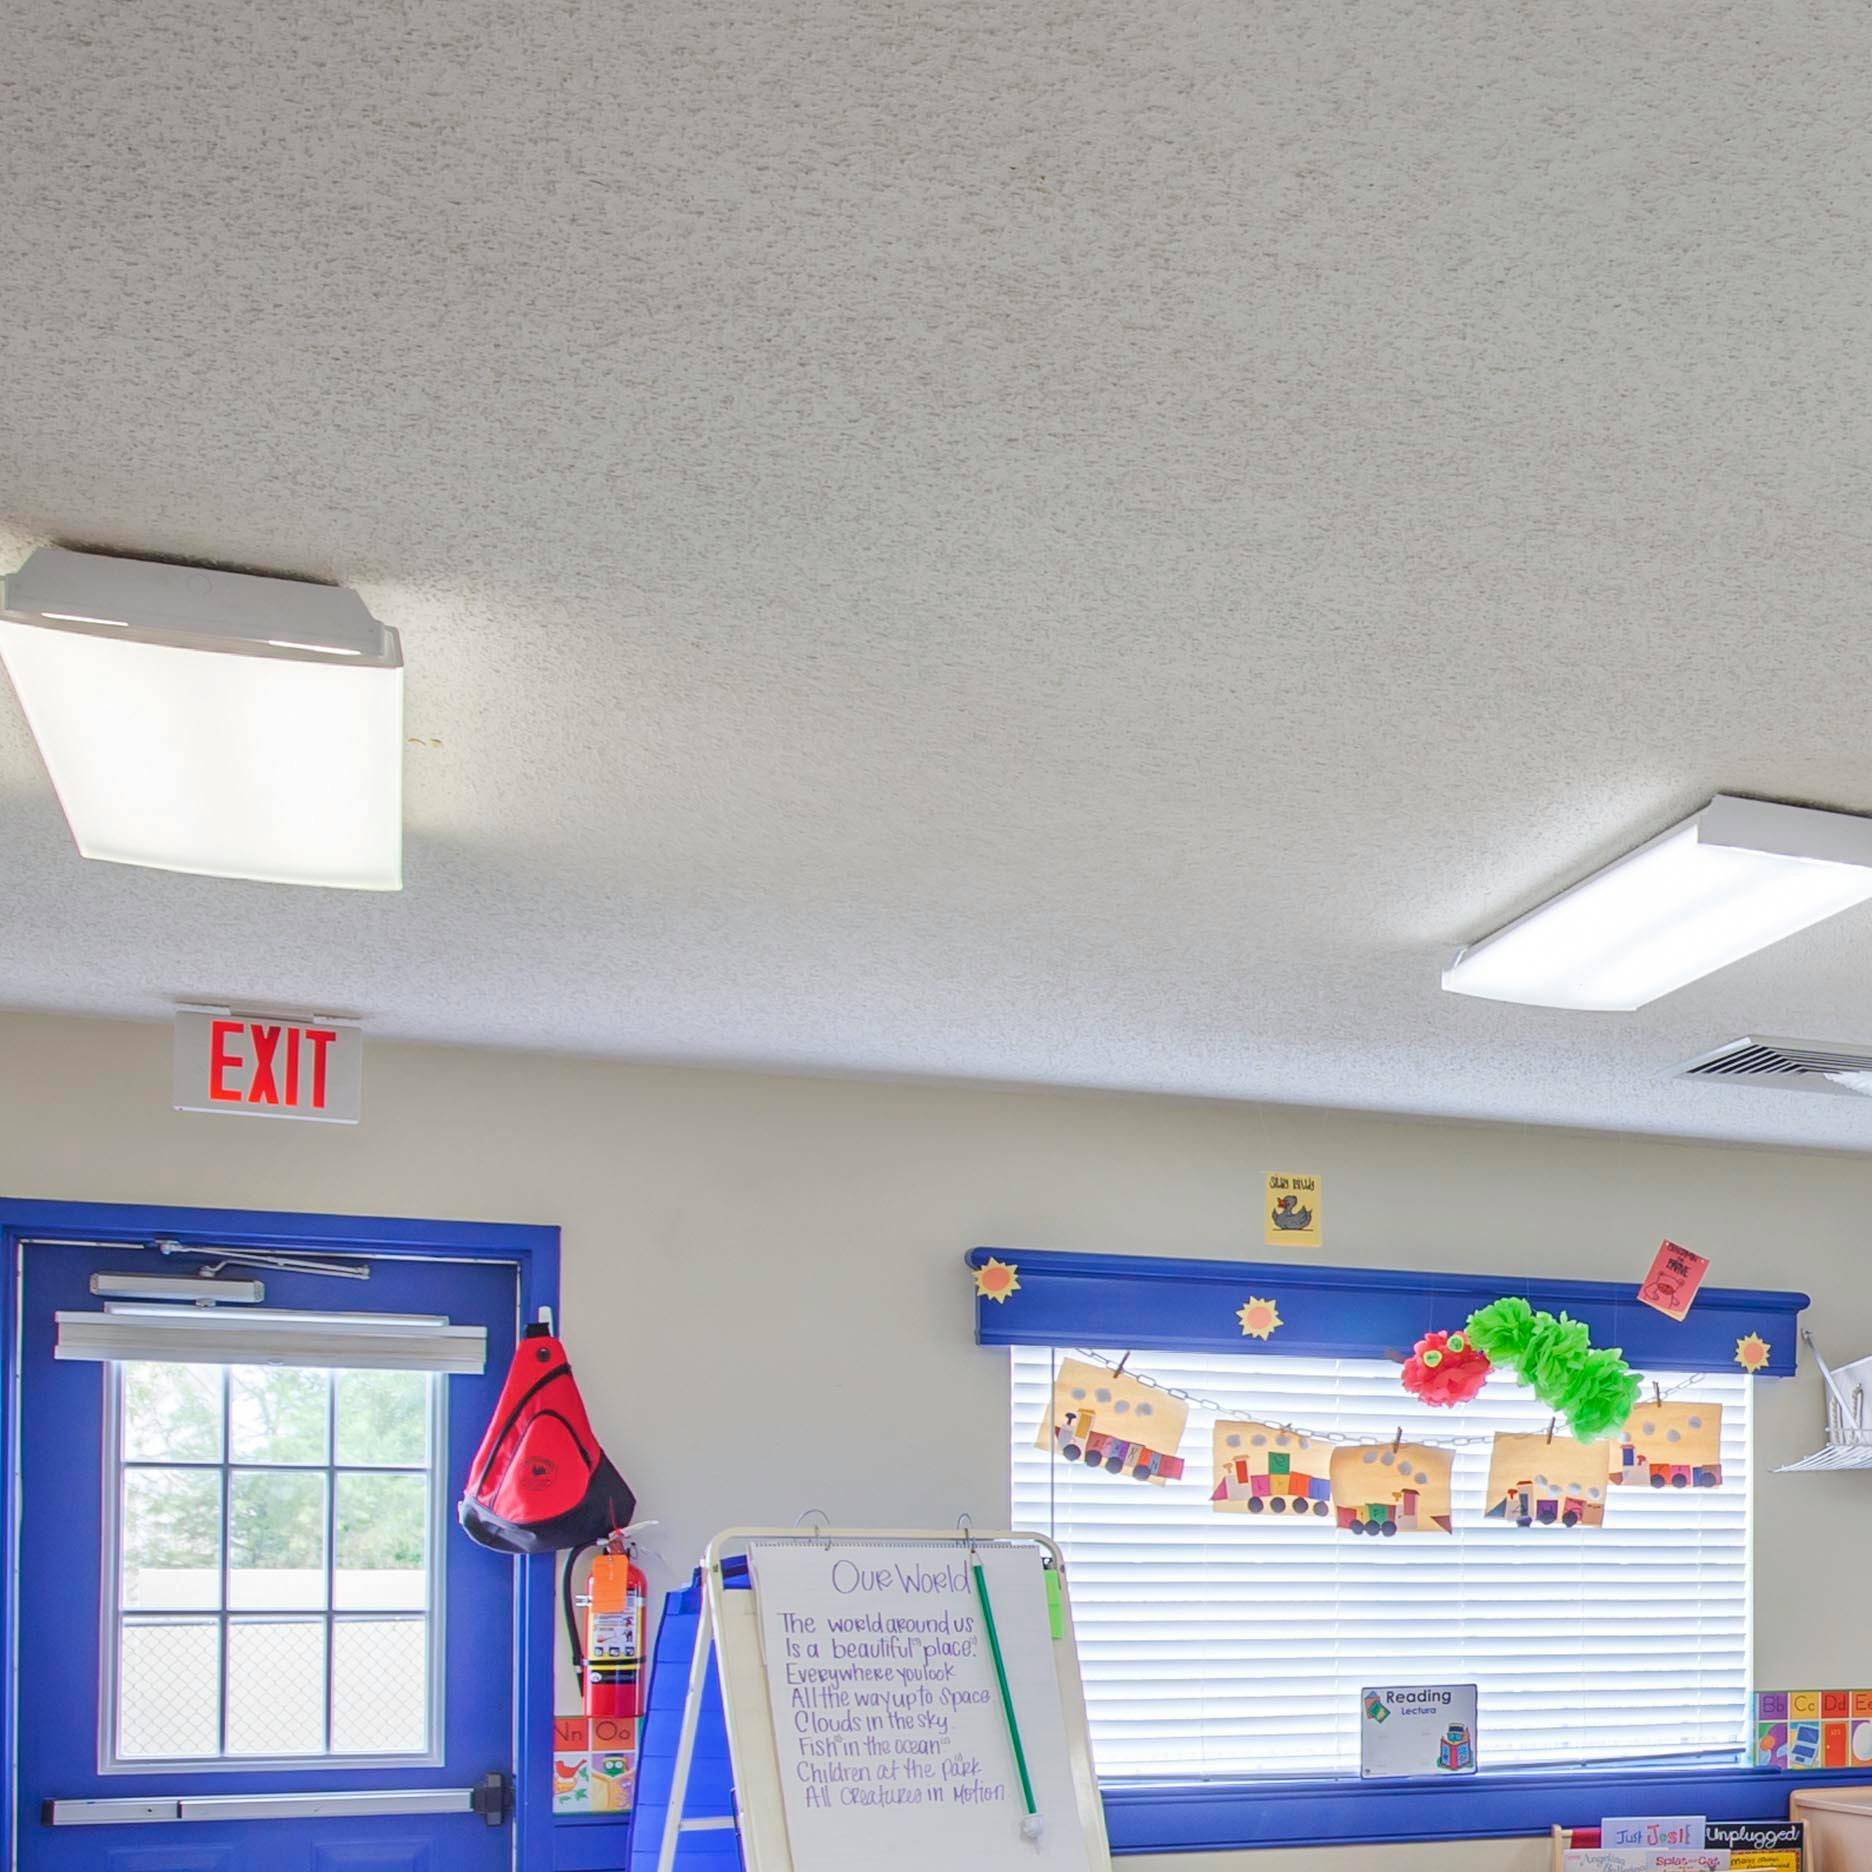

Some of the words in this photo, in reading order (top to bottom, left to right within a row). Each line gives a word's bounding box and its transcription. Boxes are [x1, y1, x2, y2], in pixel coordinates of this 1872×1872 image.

[209, 1021, 336, 1109] EXIT
[777, 1612, 817, 1634] The
[954, 1616, 975, 1634] us
[786, 1637, 800, 1658] Is
[806, 1642, 820, 1659] a
[896, 1667, 923, 1687] you
[923, 1663, 955, 1682] look
[792, 1687, 817, 1709] All
[821, 1686, 849, 1709] the
[855, 1690, 889, 1714] way
[889, 1690, 913, 1715] up
[913, 1685, 934, 1707] to
[1386, 1689, 1452, 1705] Reading
[1763, 1695, 1785, 1713] Bb
[1794, 1695, 1816, 1712] Cc
[1824, 1694, 1846, 1712] Dd
[794, 1710, 861, 1734] Clouds
[867, 1714, 884, 1731] in
[887, 1710, 913, 1730] the
[1401, 1707, 1437, 1716] Lectura
[596, 1720, 631, 1741] Oo
[799, 1736, 837, 1758] Fish
[844, 1738, 861, 1755] in
[864, 1736, 891, 1755] the
[896, 1739, 941, 1755] ocean
[796, 1760, 870, 1784] Children
[876, 1759, 897, 1779] at
[903, 1759, 936, 1779] the
[805, 1785, 830, 1808] All
[927, 1785, 943, 1803] in
[1616, 1830, 1643, 1845] Just
[1705, 1825, 1800, 1849] Unplugged
